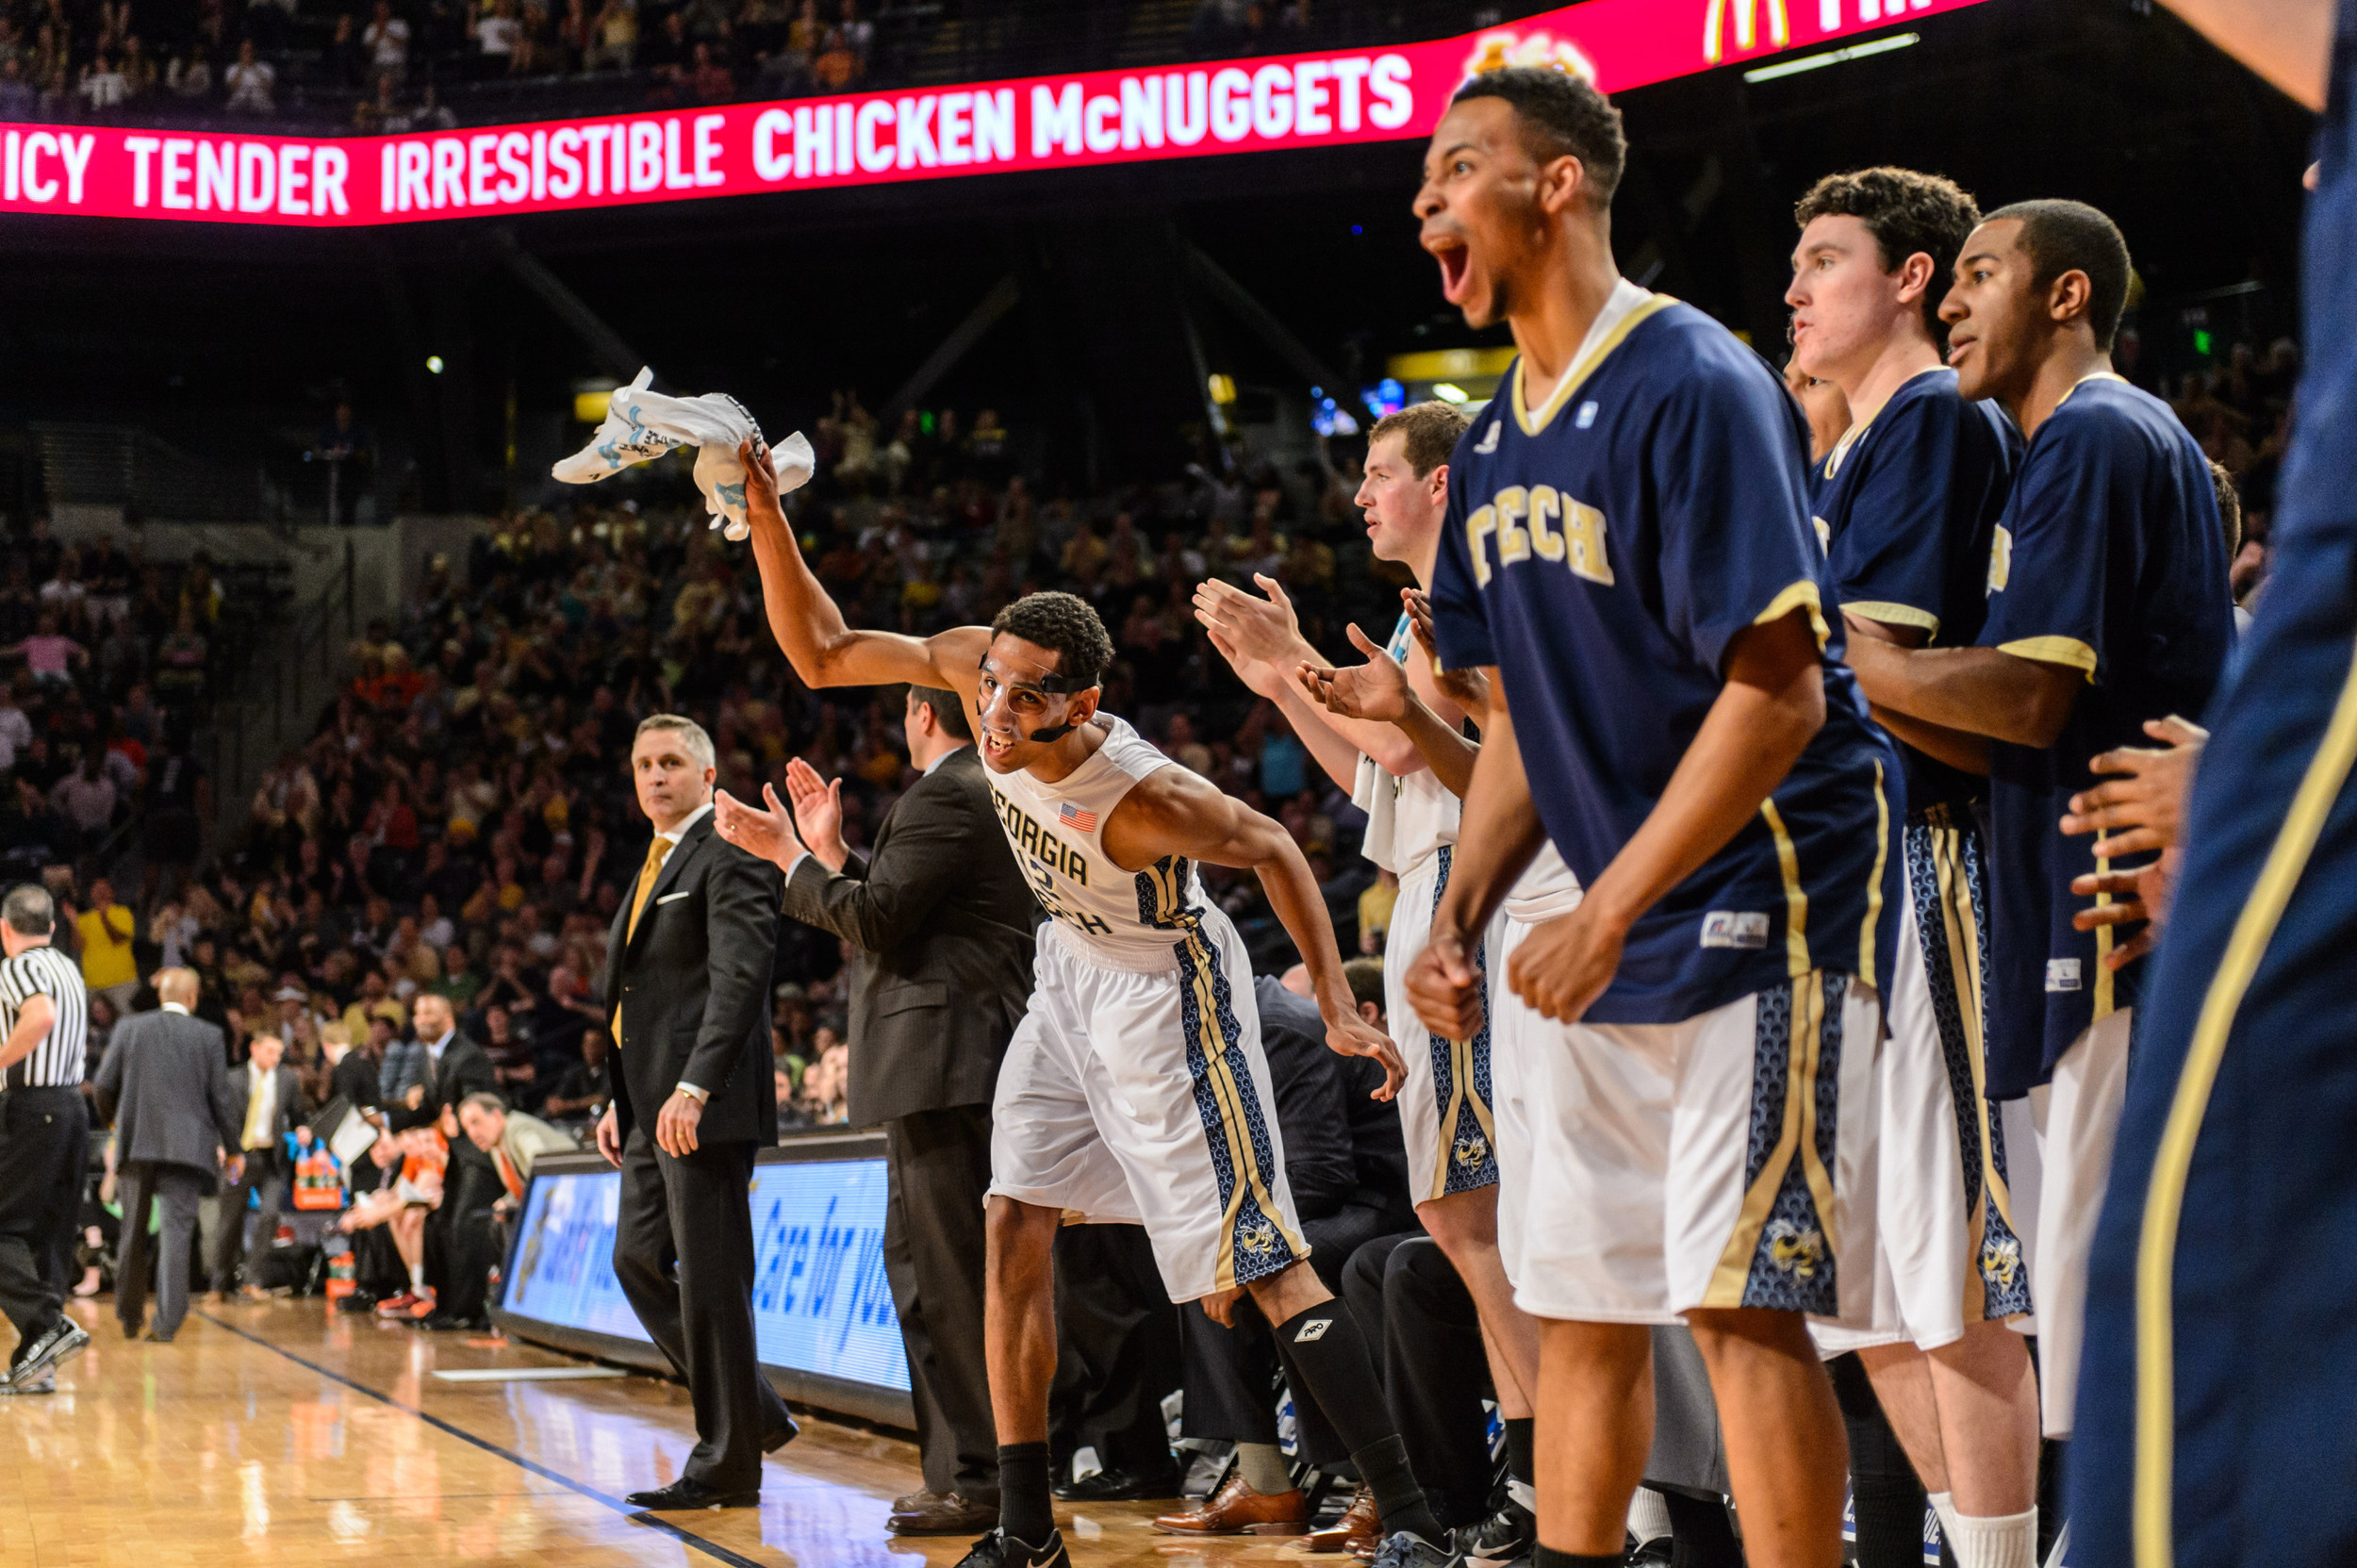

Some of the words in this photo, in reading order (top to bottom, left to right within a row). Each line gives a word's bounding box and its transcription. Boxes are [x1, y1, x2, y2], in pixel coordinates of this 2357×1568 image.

[123, 136, 350, 217] TENDER
[380, 114, 726, 214] IRRESISTIBLE
[752, 88, 1016, 181] CHICKEN
[1030, 53, 1414, 157] McNUGGETS
[1465, 483, 1616, 591] TECH
[1034, 887, 1113, 936] ECH
